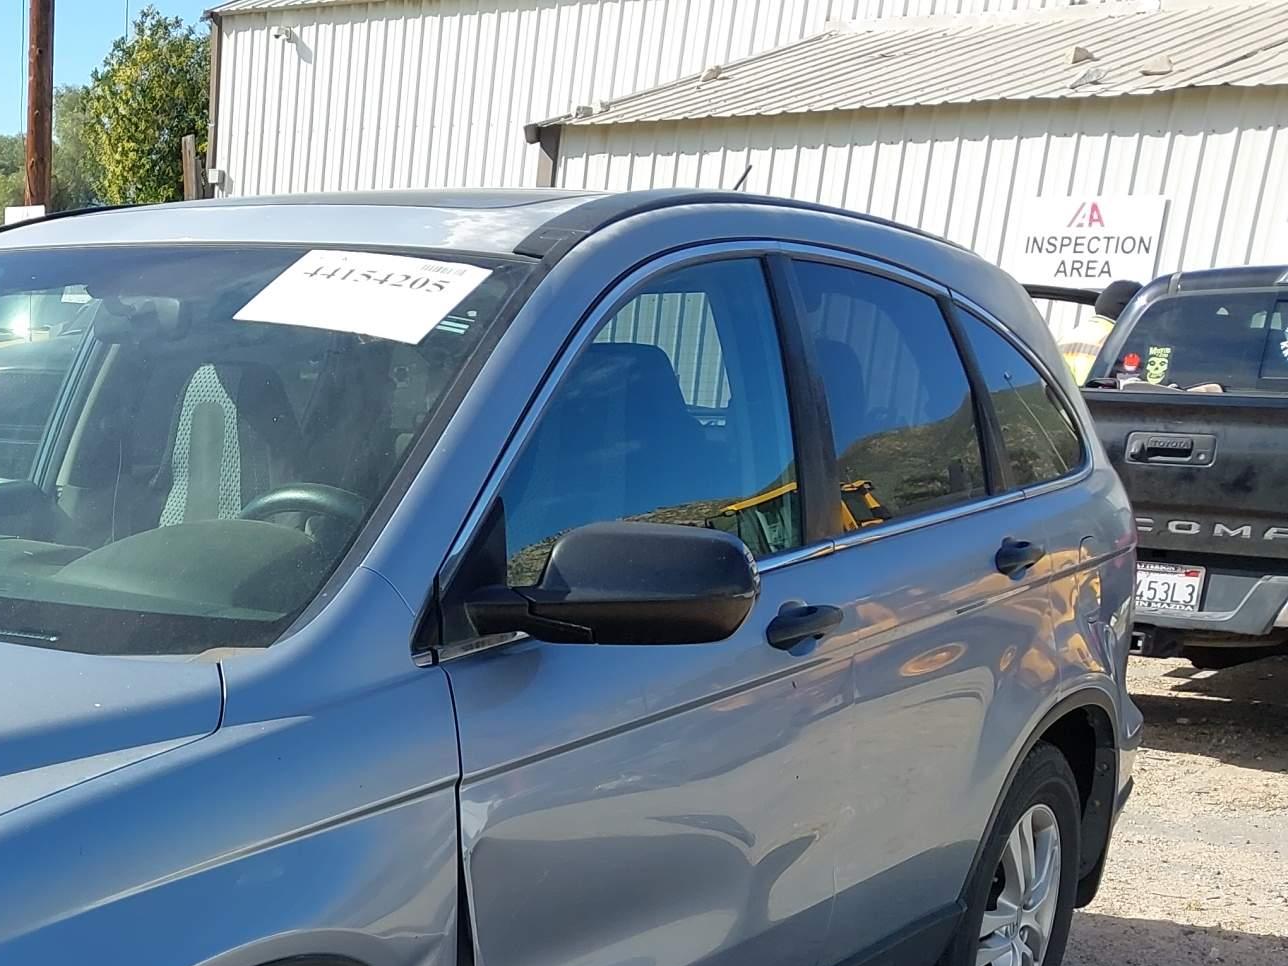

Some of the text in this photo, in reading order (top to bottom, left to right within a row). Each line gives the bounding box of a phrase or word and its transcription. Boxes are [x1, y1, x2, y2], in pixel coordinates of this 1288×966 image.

[1025, 236, 1152, 254] INSPECTION
[1054, 260, 1112, 277] AREA
[304, 266, 451, 292] 44154205
[1151, 602, 1193, 611] MAZDA
